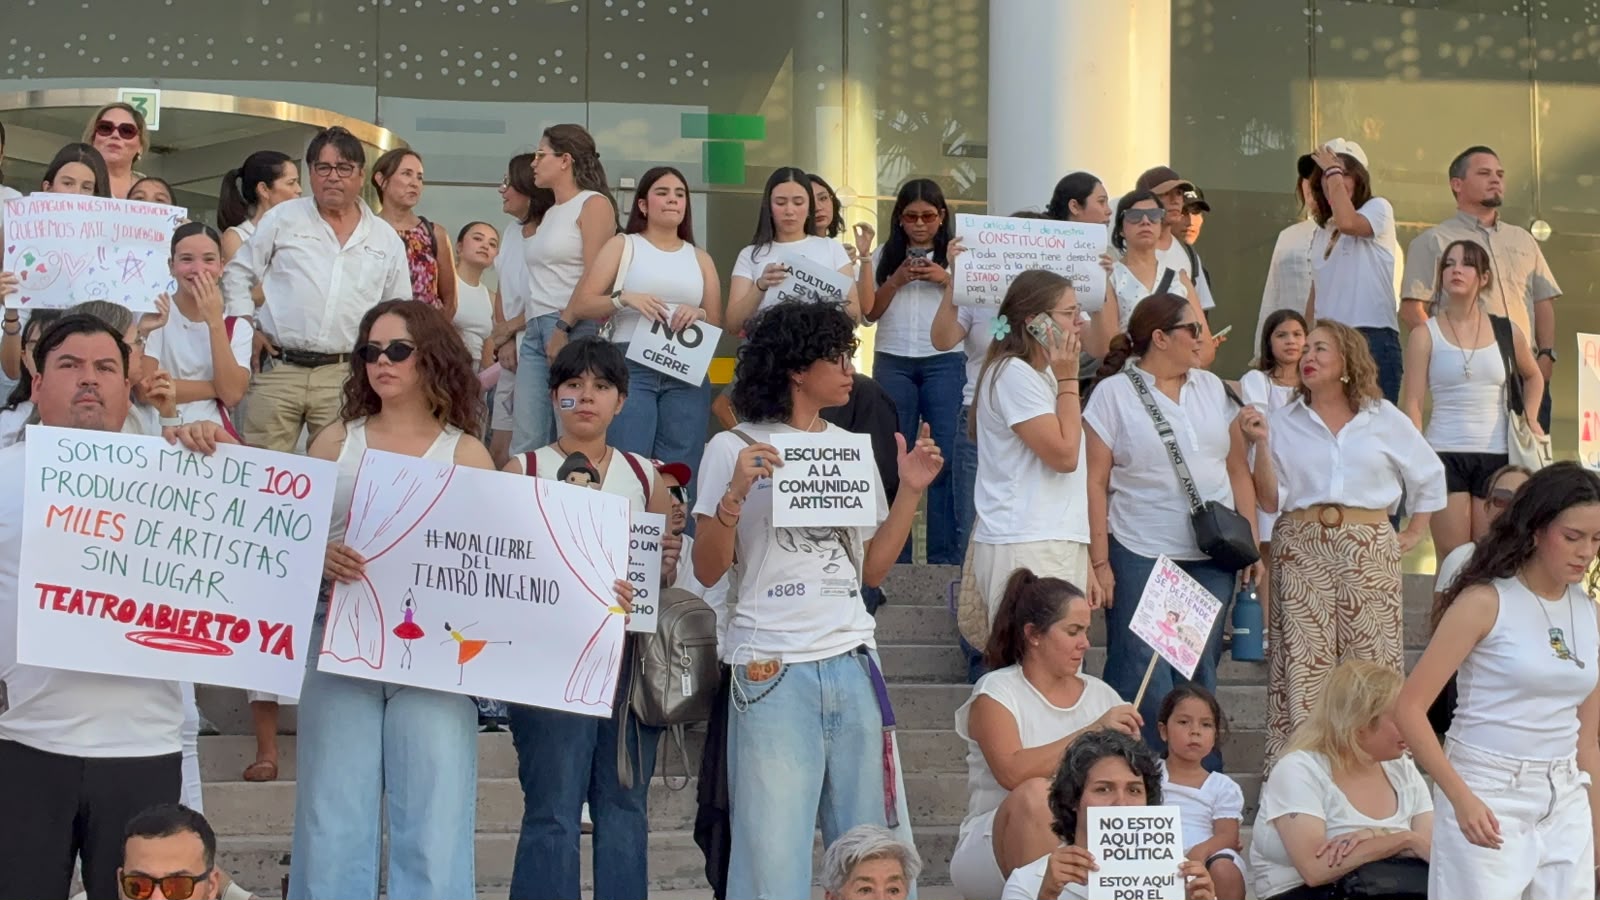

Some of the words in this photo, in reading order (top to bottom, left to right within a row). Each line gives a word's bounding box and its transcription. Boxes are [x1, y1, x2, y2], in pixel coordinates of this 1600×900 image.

[131, 96, 148, 119] 3
[7, 200, 25, 217] NO
[77, 201, 121, 213] NUESTRA
[9, 220, 75, 241] QUEREMOS
[80, 221, 108, 239] ARTE
[1023, 221, 1032, 232] 4
[1040, 225, 1051, 235] de
[1054, 227, 1084, 236] nuestra
[978, 231, 1065, 249] CONSTITUCIÓN
[1073, 240, 1096, 249] dice:
[969, 248, 996, 259] Toda
[1003, 251, 1037, 264] persona
[1040, 251, 1061, 261] tiene
[1066, 252, 1097, 262] derecho
[964, 260, 973, 270] al
[976, 263, 1001, 271] acceso
[1014, 261, 1023, 270] la
[1066, 264, 1075, 272] el
[795, 270, 842, 299] CULTURA
[966, 271, 1000, 282] ESTADO
[793, 283, 807, 296] ES
[966, 285, 985, 295] para
[990, 283, 998, 292] la
[975, 294, 986, 304] de
[650, 317, 704, 349] NO
[661, 343, 678, 356] AL
[642, 348, 691, 375] CIERRE
[1131, 373, 1148, 395] DKNY
[1147, 403, 1165, 424] KNY
[784, 448, 861, 461] ESCUCHEN
[1168, 440, 1183, 465] DKN
[57, 438, 148, 469] SOMOS
[222, 456, 256, 487] DE
[258, 466, 311, 499] 100
[808, 464, 820, 477] A
[822, 464, 842, 477] LA
[779, 480, 870, 494] COMUNIDAD
[1182, 476, 1200, 507] DKNY
[41, 466, 217, 522] PRODUCCIONES
[222, 497, 246, 528] AL
[253, 503, 312, 541] AÑO
[789, 492, 863, 509] ARTÍSTICA
[46, 504, 126, 542] MILES
[134, 518, 164, 548] DE
[167, 526, 290, 578] ARTISTAS
[641, 541, 658, 552] UN
[81, 546, 128, 576] SIN
[462, 553, 492, 570] DEL
[1161, 557, 1168, 565] EL
[412, 563, 478, 596] TEATRO
[485, 572, 560, 605] INGENIO
[1160, 565, 1179, 586] NO
[767, 583, 806, 598] #808
[1154, 573, 1167, 588] SE
[1169, 583, 1209, 622] DEFIENDE
[257, 619, 295, 660] YA
[1100, 818, 1124, 830] NO
[1128, 817, 1174, 830] ESTOY
[1099, 829, 1139, 848] AQUÍ
[1143, 832, 1175, 845] POR
[1103, 845, 1174, 861] POLÍTICA
[1100, 876, 1140, 887] ESTOY
[1143, 873, 1175, 888] AQUÍ
[1114, 889, 1144, 900] POR
[1147, 889, 1164, 900] EL
